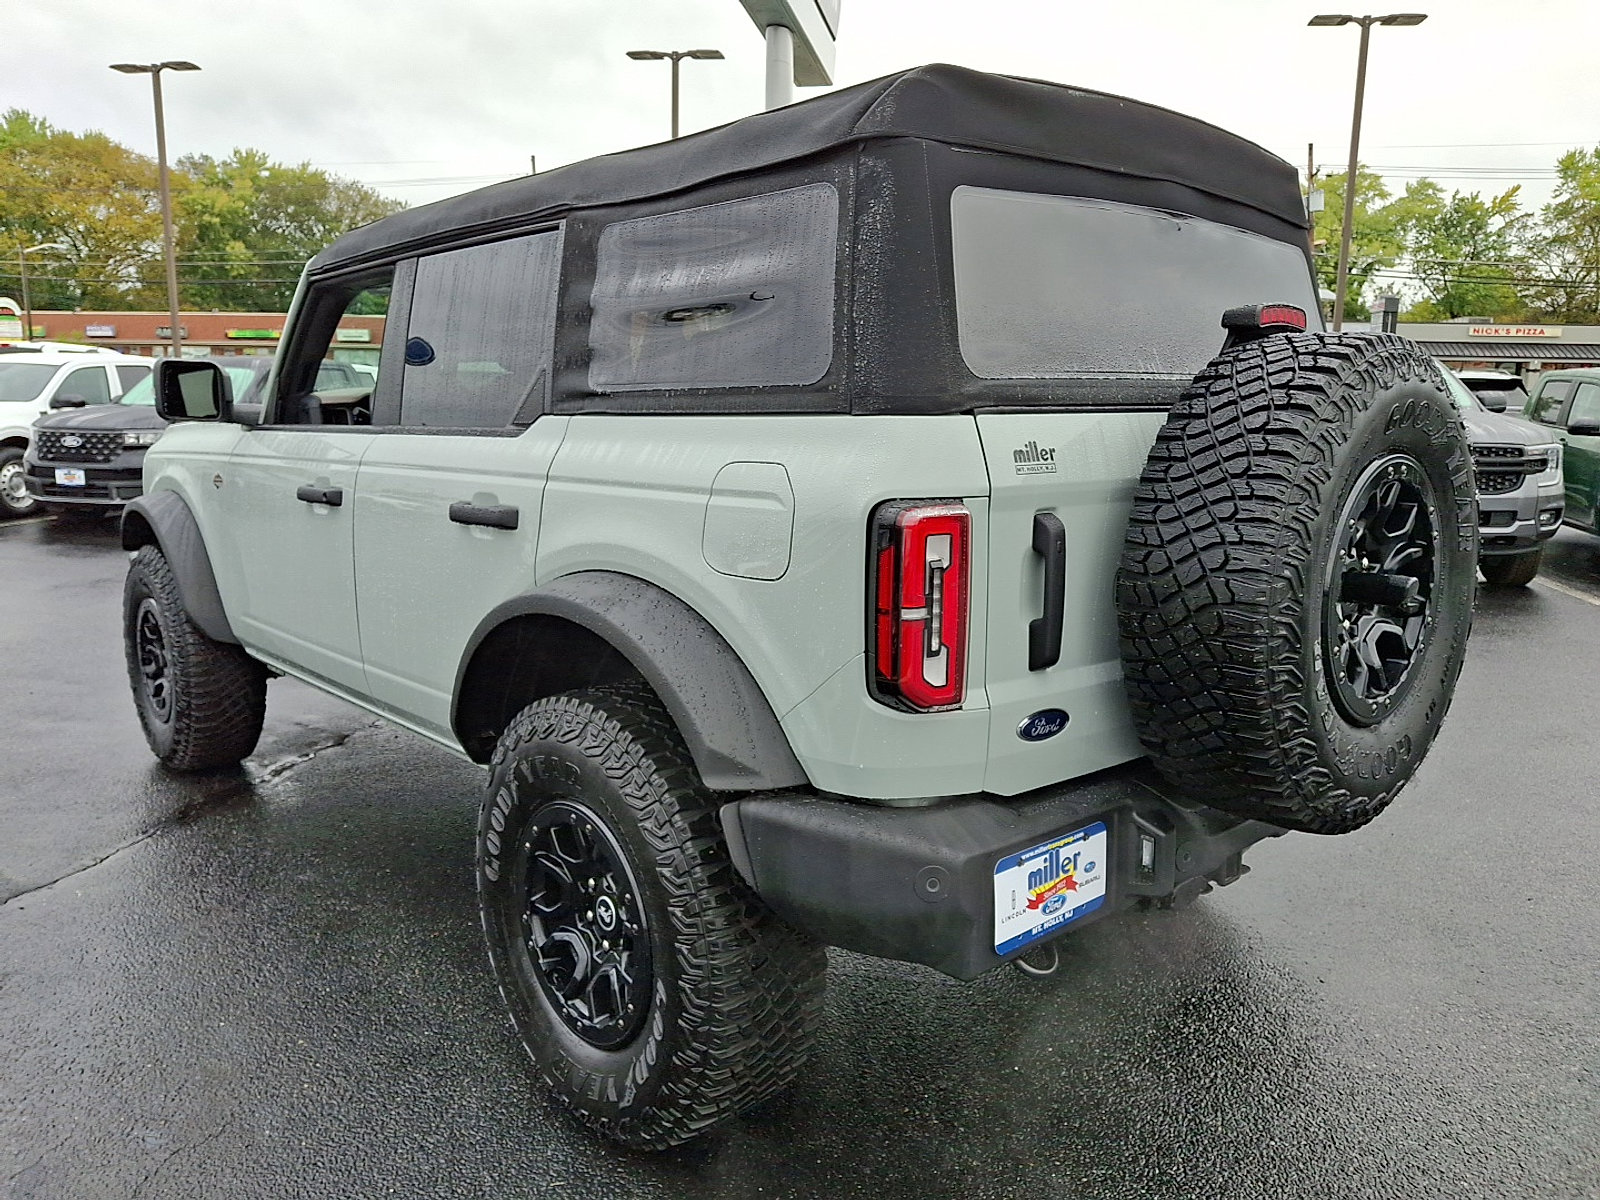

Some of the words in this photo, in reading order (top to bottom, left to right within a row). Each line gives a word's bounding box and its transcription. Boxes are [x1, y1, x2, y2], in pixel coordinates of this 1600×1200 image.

[1472, 327, 1512, 336] NICK'S
[1515, 328, 1546, 336] PIZZA
[1013, 440, 1056, 463] miller
[1028, 848, 1081, 892] miller
[1001, 908, 1027, 924] LINCOLN
